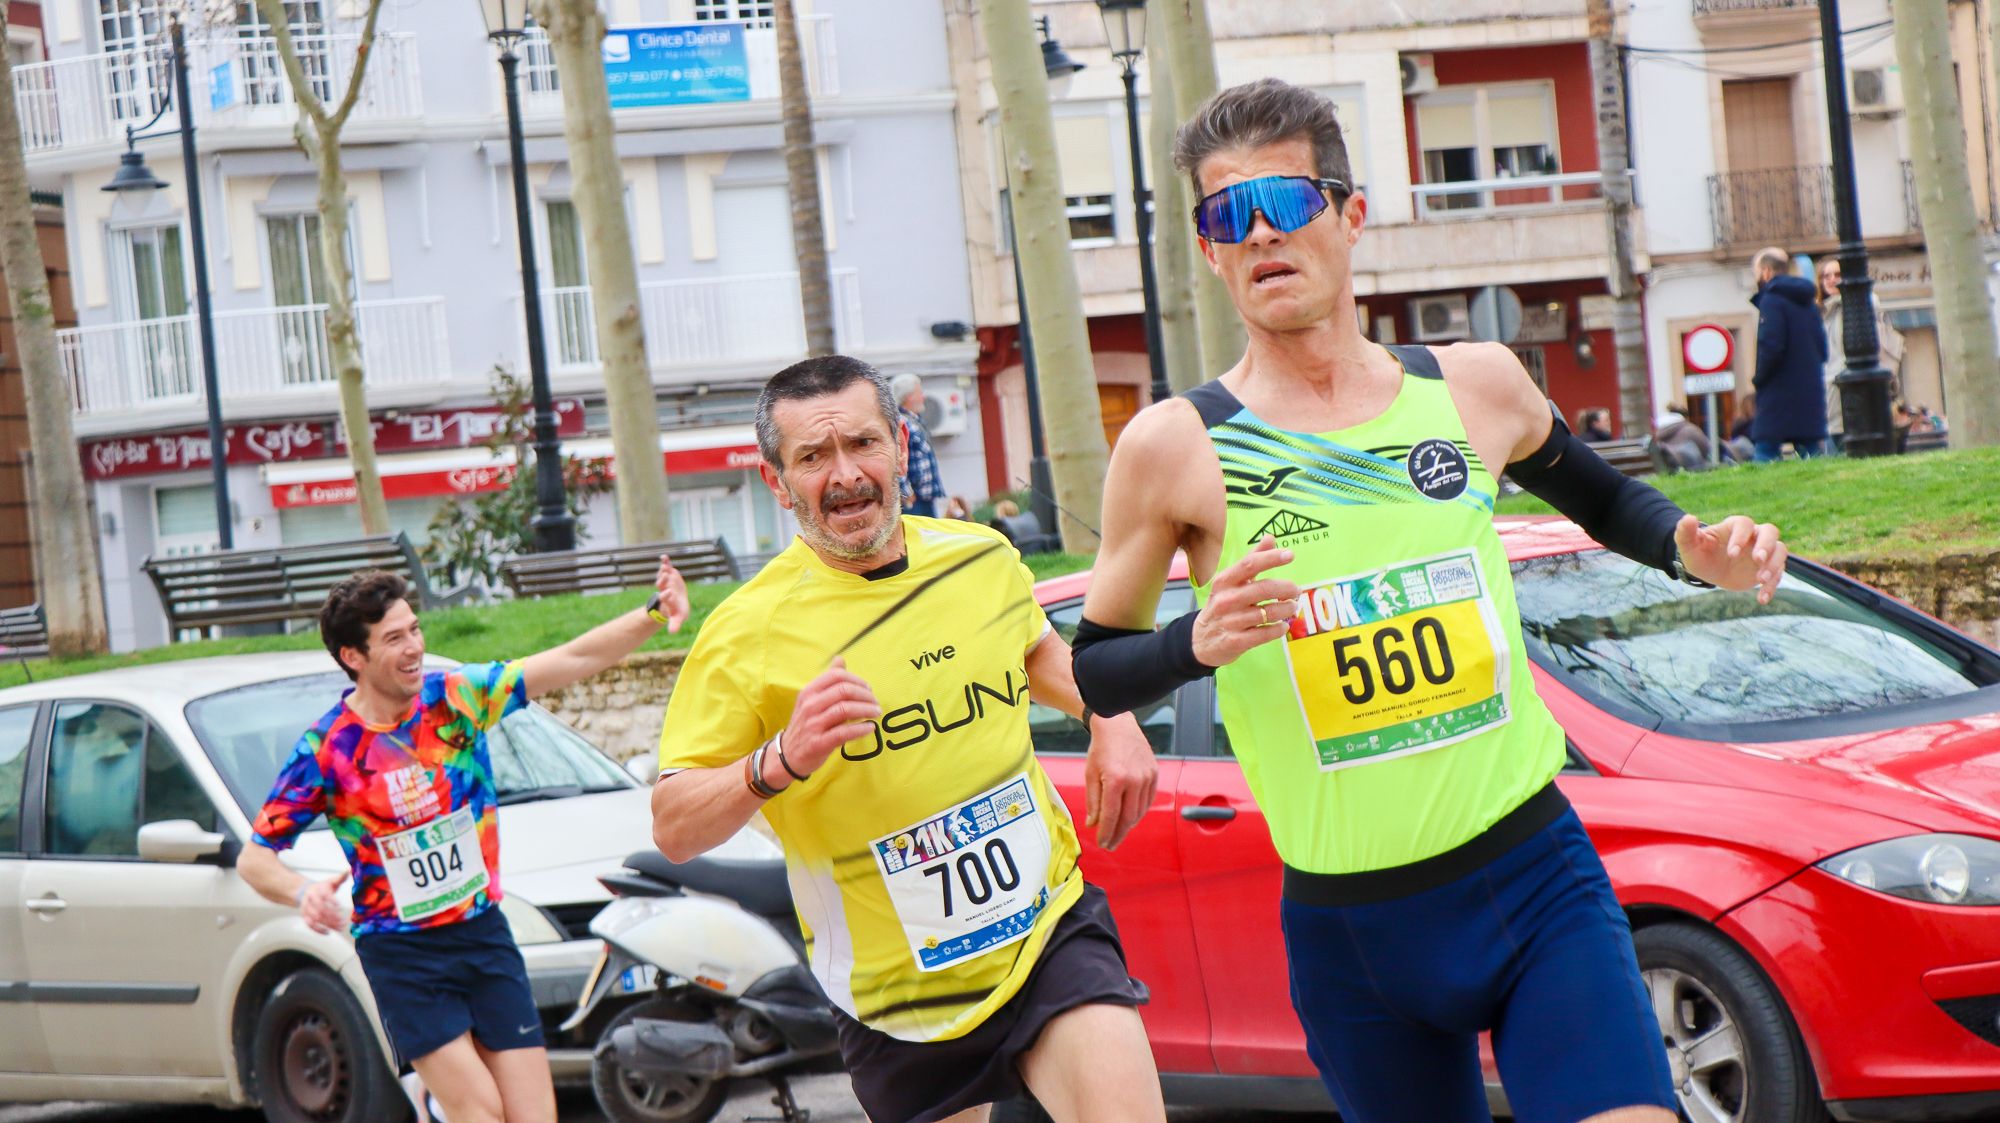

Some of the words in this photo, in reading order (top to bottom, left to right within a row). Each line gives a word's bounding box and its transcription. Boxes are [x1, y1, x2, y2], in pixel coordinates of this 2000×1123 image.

[684, 30, 731, 47] Dental
[1296, 582, 1362, 635] 10K
[910, 645, 956, 670] vive
[1333, 617, 1455, 705] 560
[1353, 709, 1380, 719] ANTONIO
[1381, 704, 1406, 713] MANUEL
[903, 818, 956, 866] 21K
[408, 843, 463, 888] 904
[923, 838, 1021, 918] 700
[965, 912, 984, 922] MANUEL
